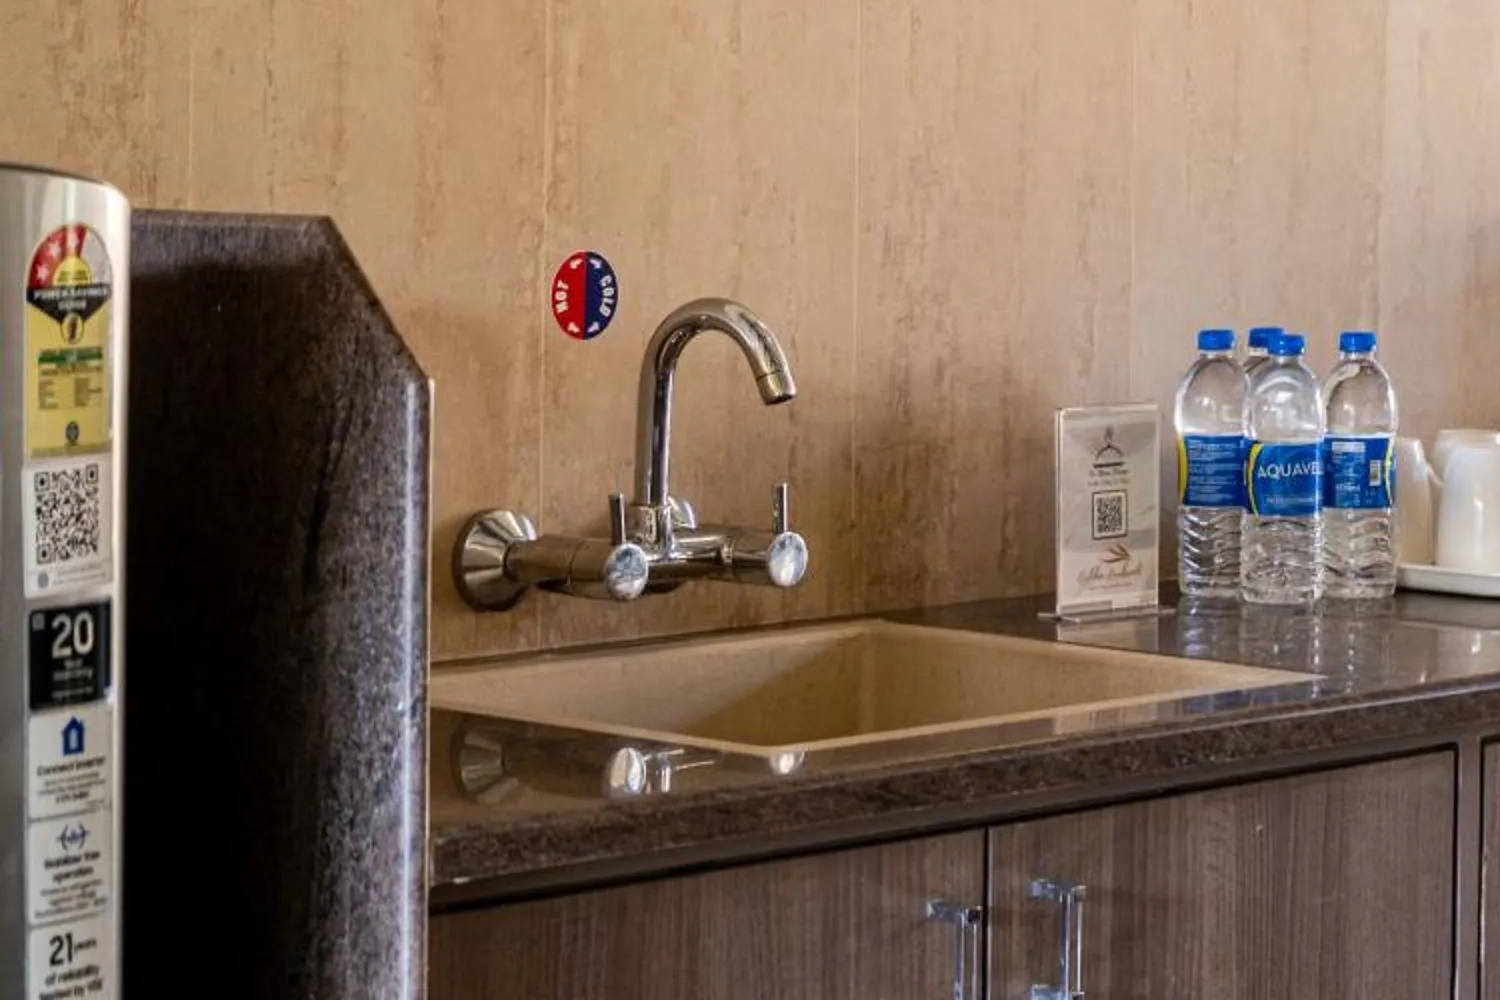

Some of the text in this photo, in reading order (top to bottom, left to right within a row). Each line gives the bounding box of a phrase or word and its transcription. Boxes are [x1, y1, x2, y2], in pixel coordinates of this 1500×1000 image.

[555, 280, 569, 314] HOT
[599, 275, 615, 317] COLD
[51, 610, 94, 659] 20
[48, 932, 73, 967] 21
